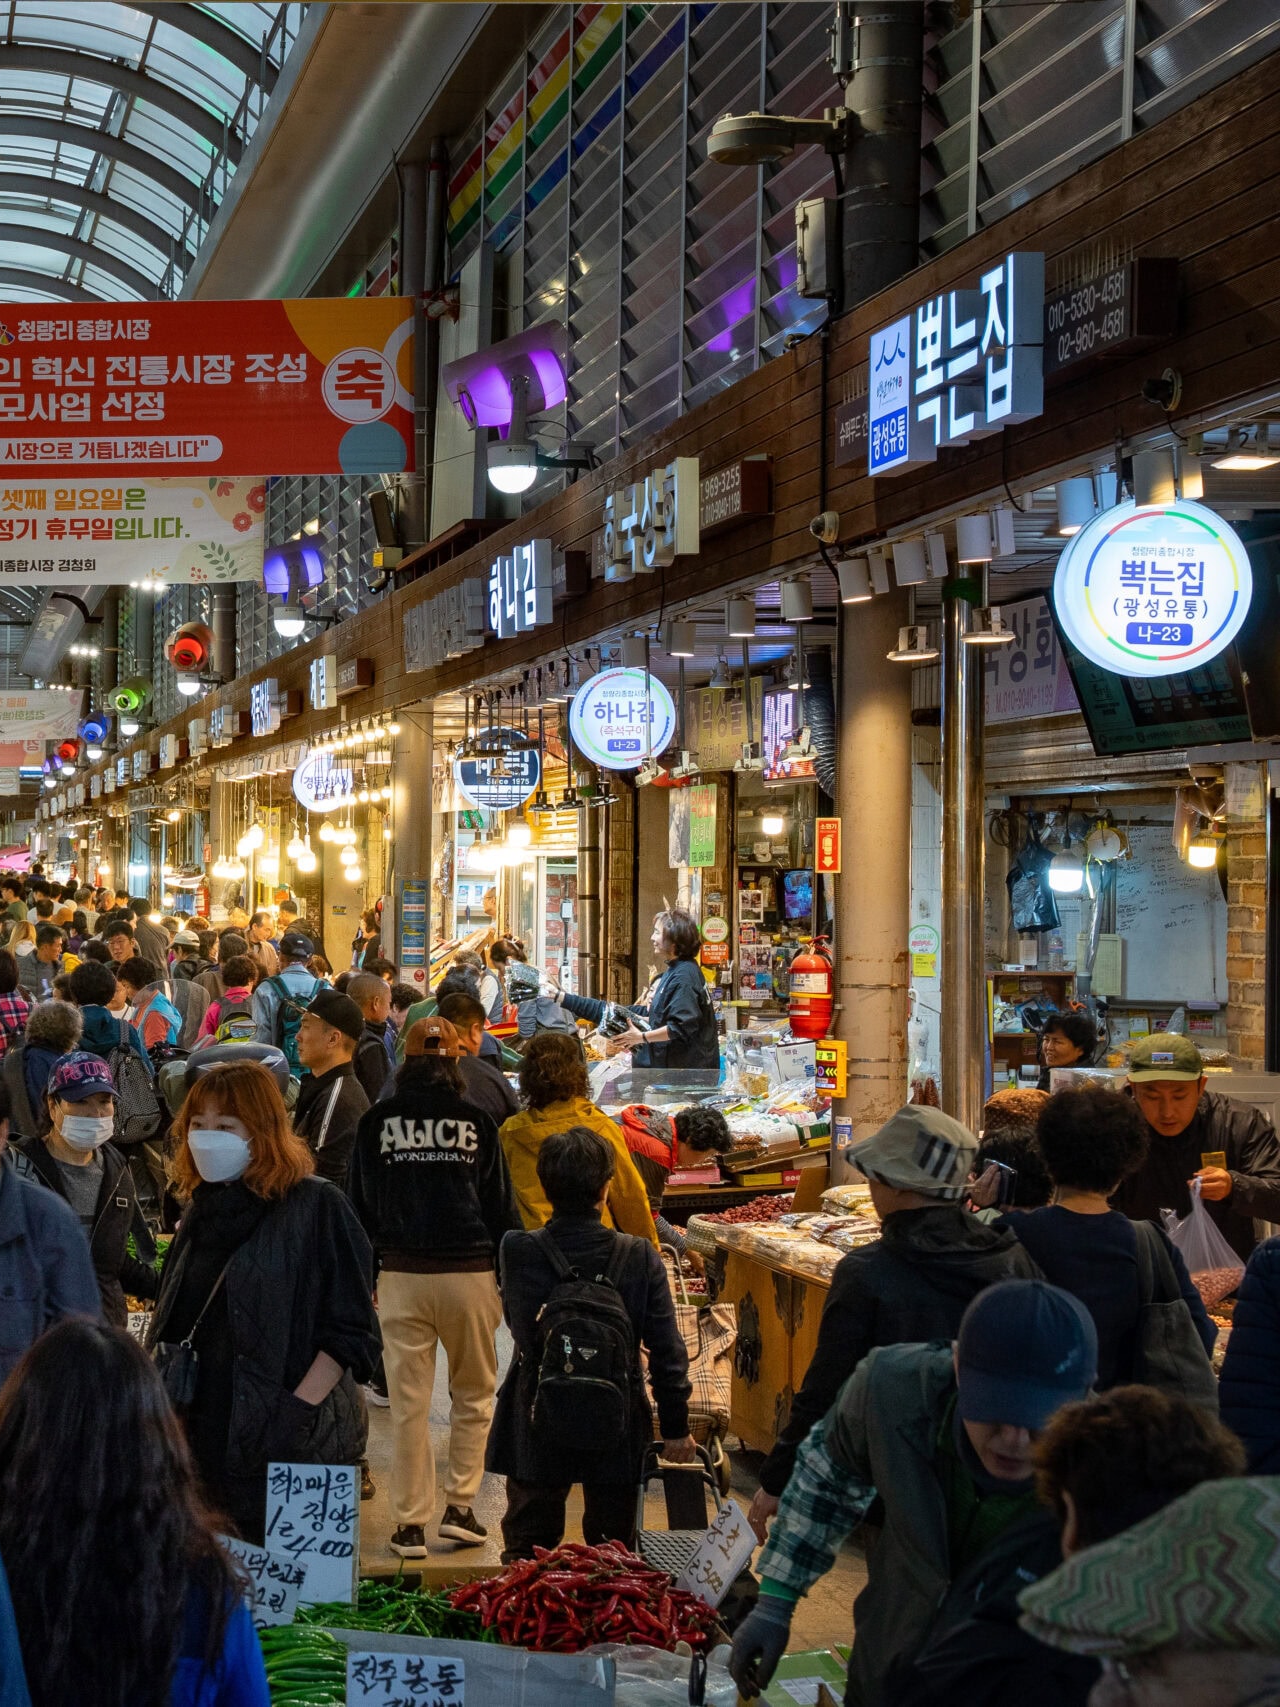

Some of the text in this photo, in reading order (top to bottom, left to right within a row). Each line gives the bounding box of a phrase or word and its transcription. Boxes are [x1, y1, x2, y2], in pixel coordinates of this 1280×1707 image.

[1049, 269, 1125, 332] 010-5330-4581
[18, 319, 151, 341] 청량리 종합시장
[1058, 306, 1124, 362] 02-960-4581
[32, 356, 95, 387] 혁신
[106, 354, 234, 386] 전통시장
[244, 353, 308, 383] 조성
[335, 360, 385, 410] 축
[102, 391, 166, 422] 선정
[5, 442, 73, 460] 시장으로
[79, 439, 209, 459] 거듭나겠습니다"
[872, 415, 907, 461] 광성유통
[1, 488, 47, 511] 셋째
[54, 487, 146, 511] 일요일은
[45, 517, 190, 541] 휴무일입니다.
[58, 558, 96, 573] 경청회
[489, 540, 537, 639] 하나김
[1113, 598, 1208, 619] (광성유통)
[1138, 625, 1182, 642] 나-23
[594, 701, 655, 723] 하나김
[600, 726, 649, 737] (즉석구이
[512, 777, 530, 785] 1975
[380, 1115, 478, 1154] ALICE
[393, 1151, 475, 1164] WONDERLAND
